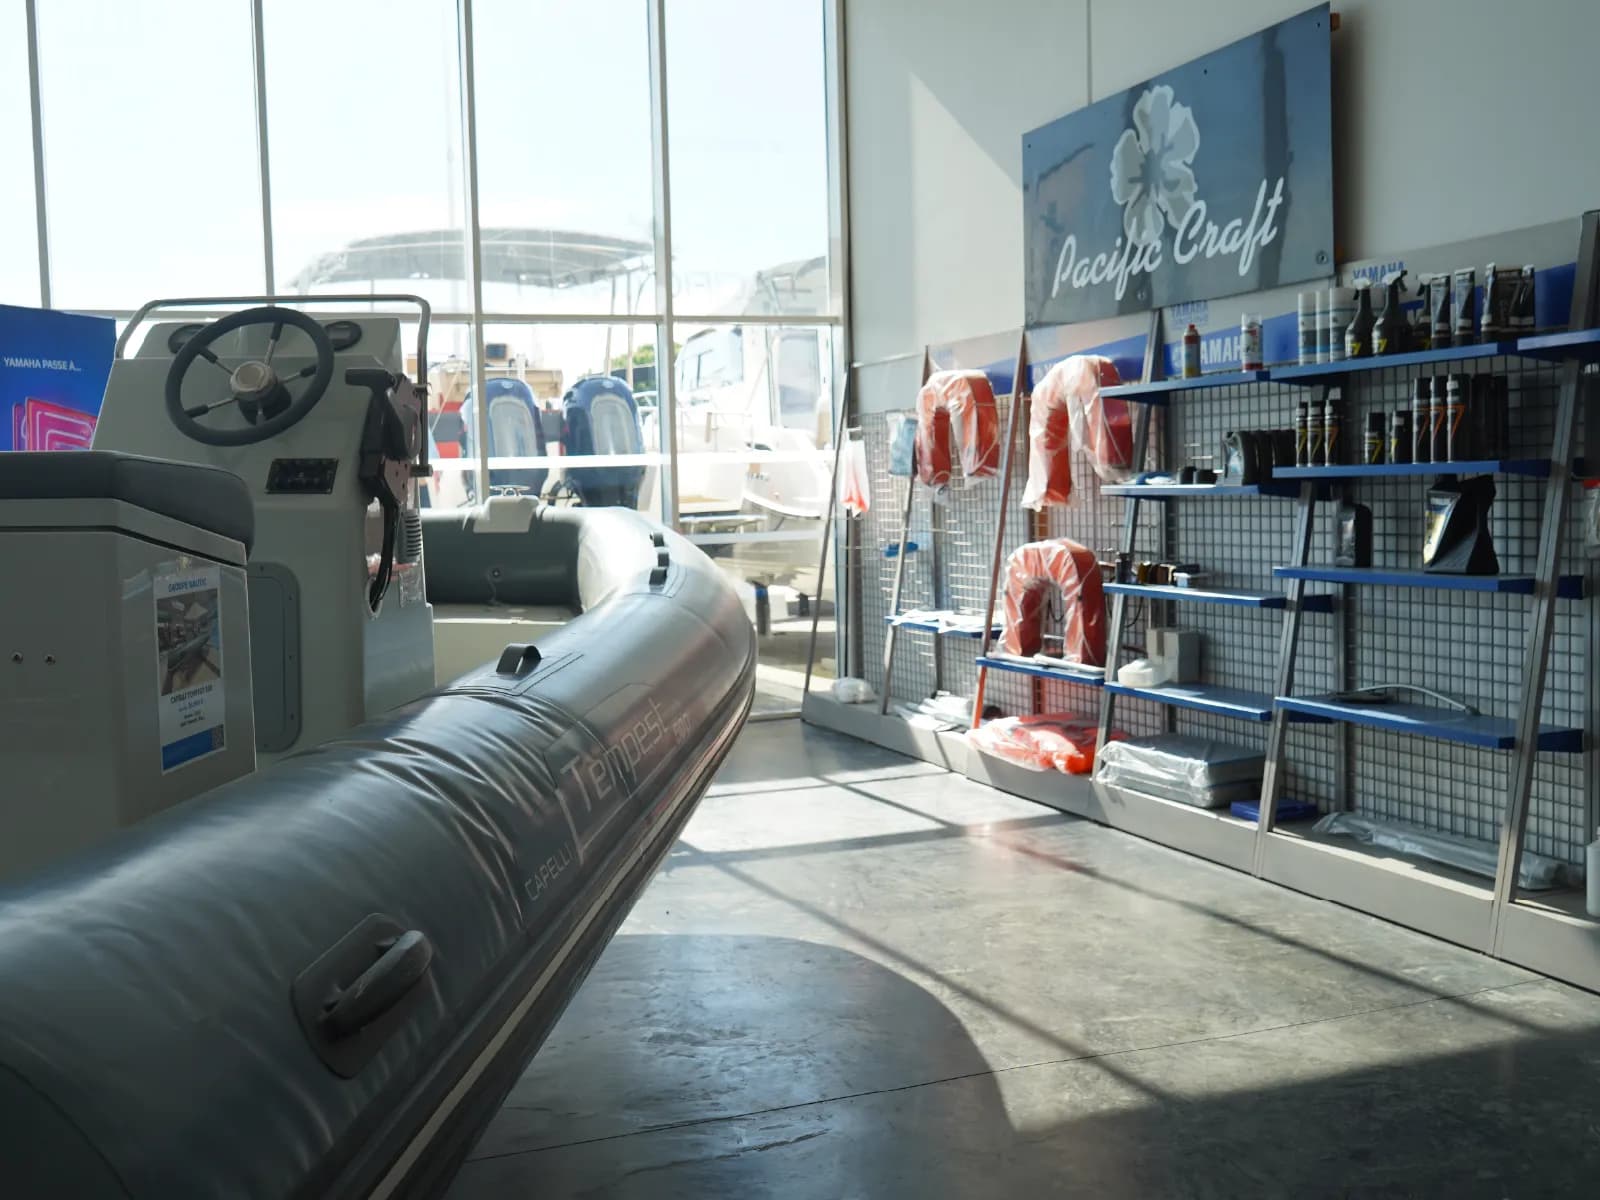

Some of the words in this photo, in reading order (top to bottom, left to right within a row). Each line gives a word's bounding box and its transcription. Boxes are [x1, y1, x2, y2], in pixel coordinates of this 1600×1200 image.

[1051, 217, 1163, 301] Pacific
[1173, 176, 1285, 277] Craft
[3, 357, 41, 369] YAMAHA
[42, 359, 68, 370] PASSE
